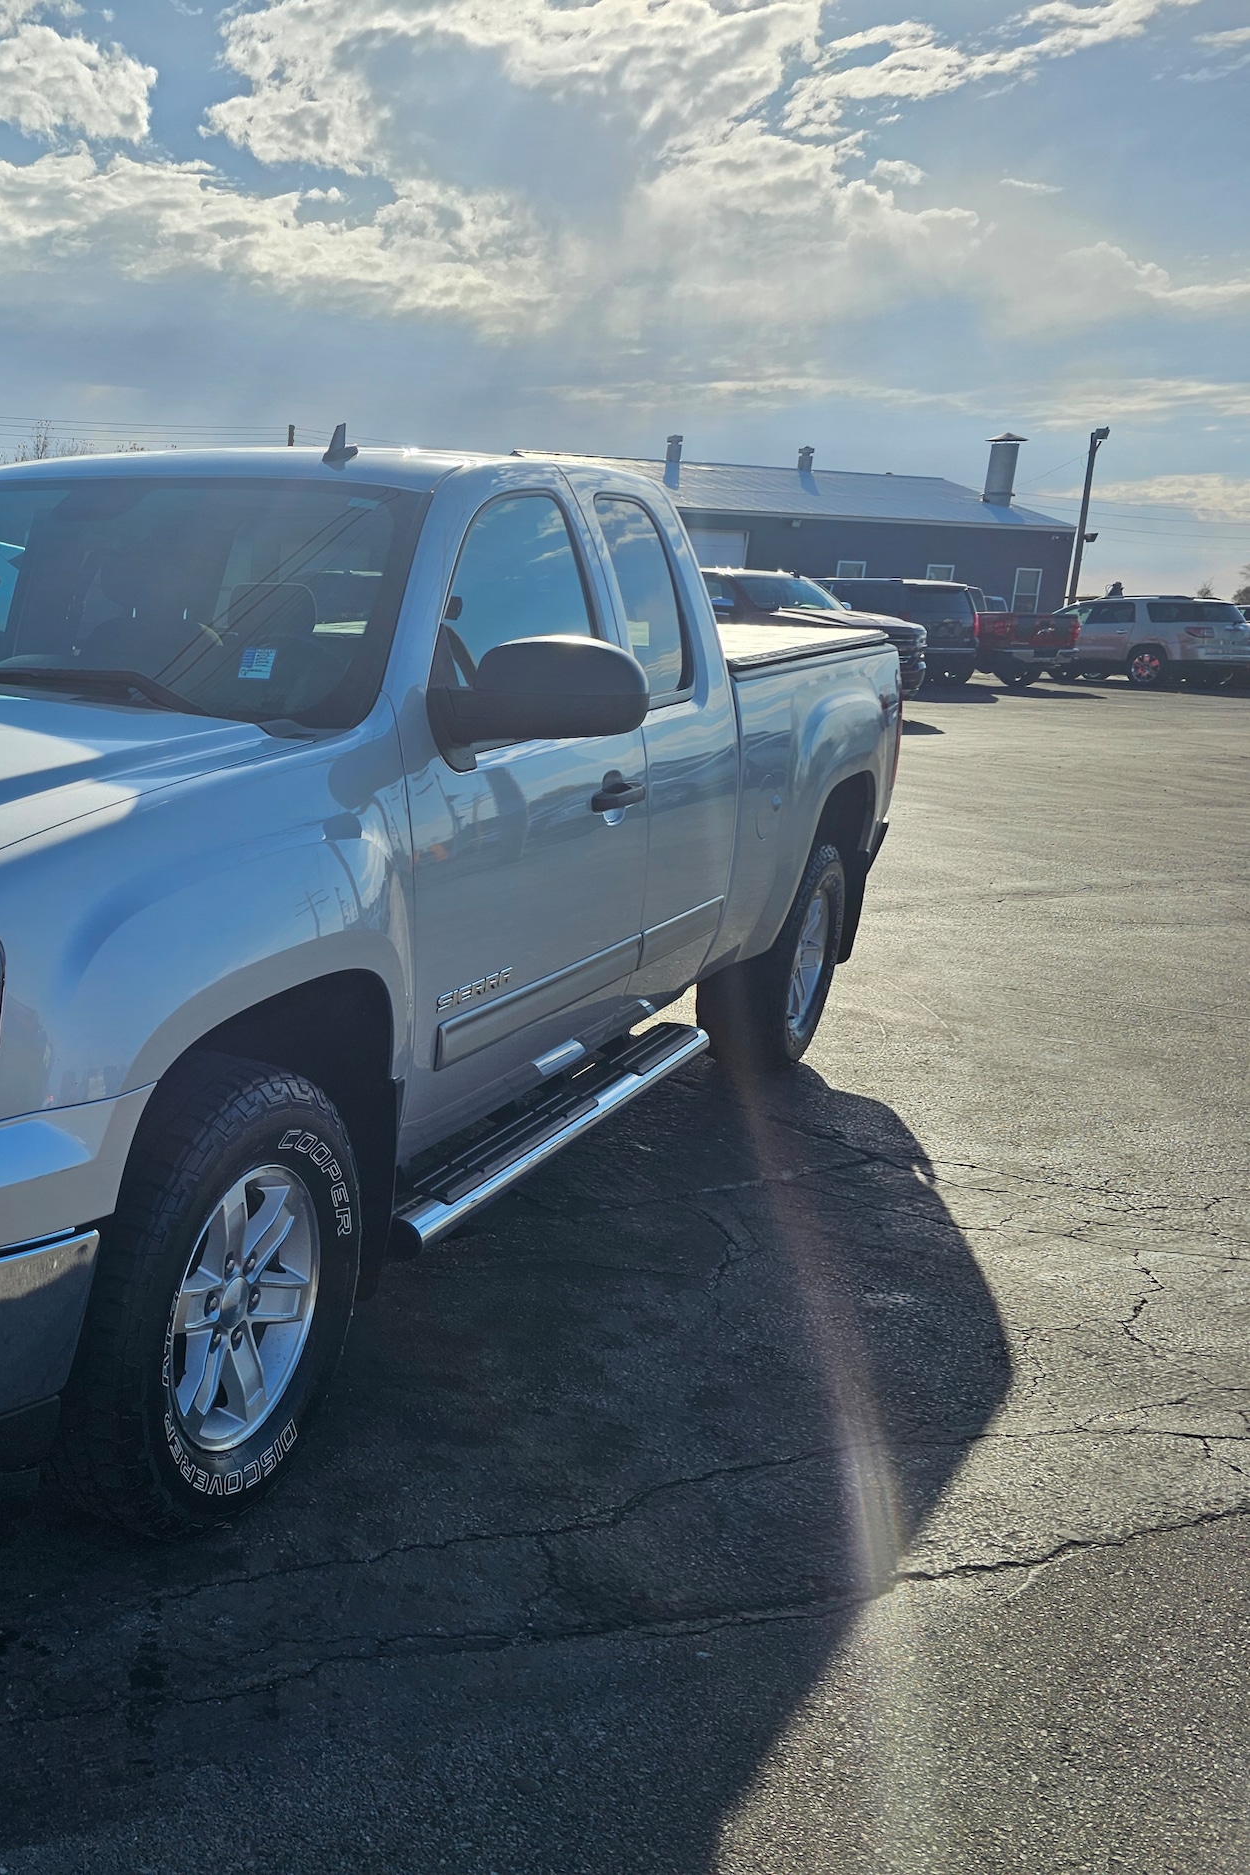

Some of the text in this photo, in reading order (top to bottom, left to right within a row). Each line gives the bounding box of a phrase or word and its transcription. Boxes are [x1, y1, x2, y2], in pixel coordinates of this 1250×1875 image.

[436, 966, 513, 1014] SIERRA
[278, 1129, 352, 1236] COOPER
[163, 1410, 299, 1496] DISCOVERER
